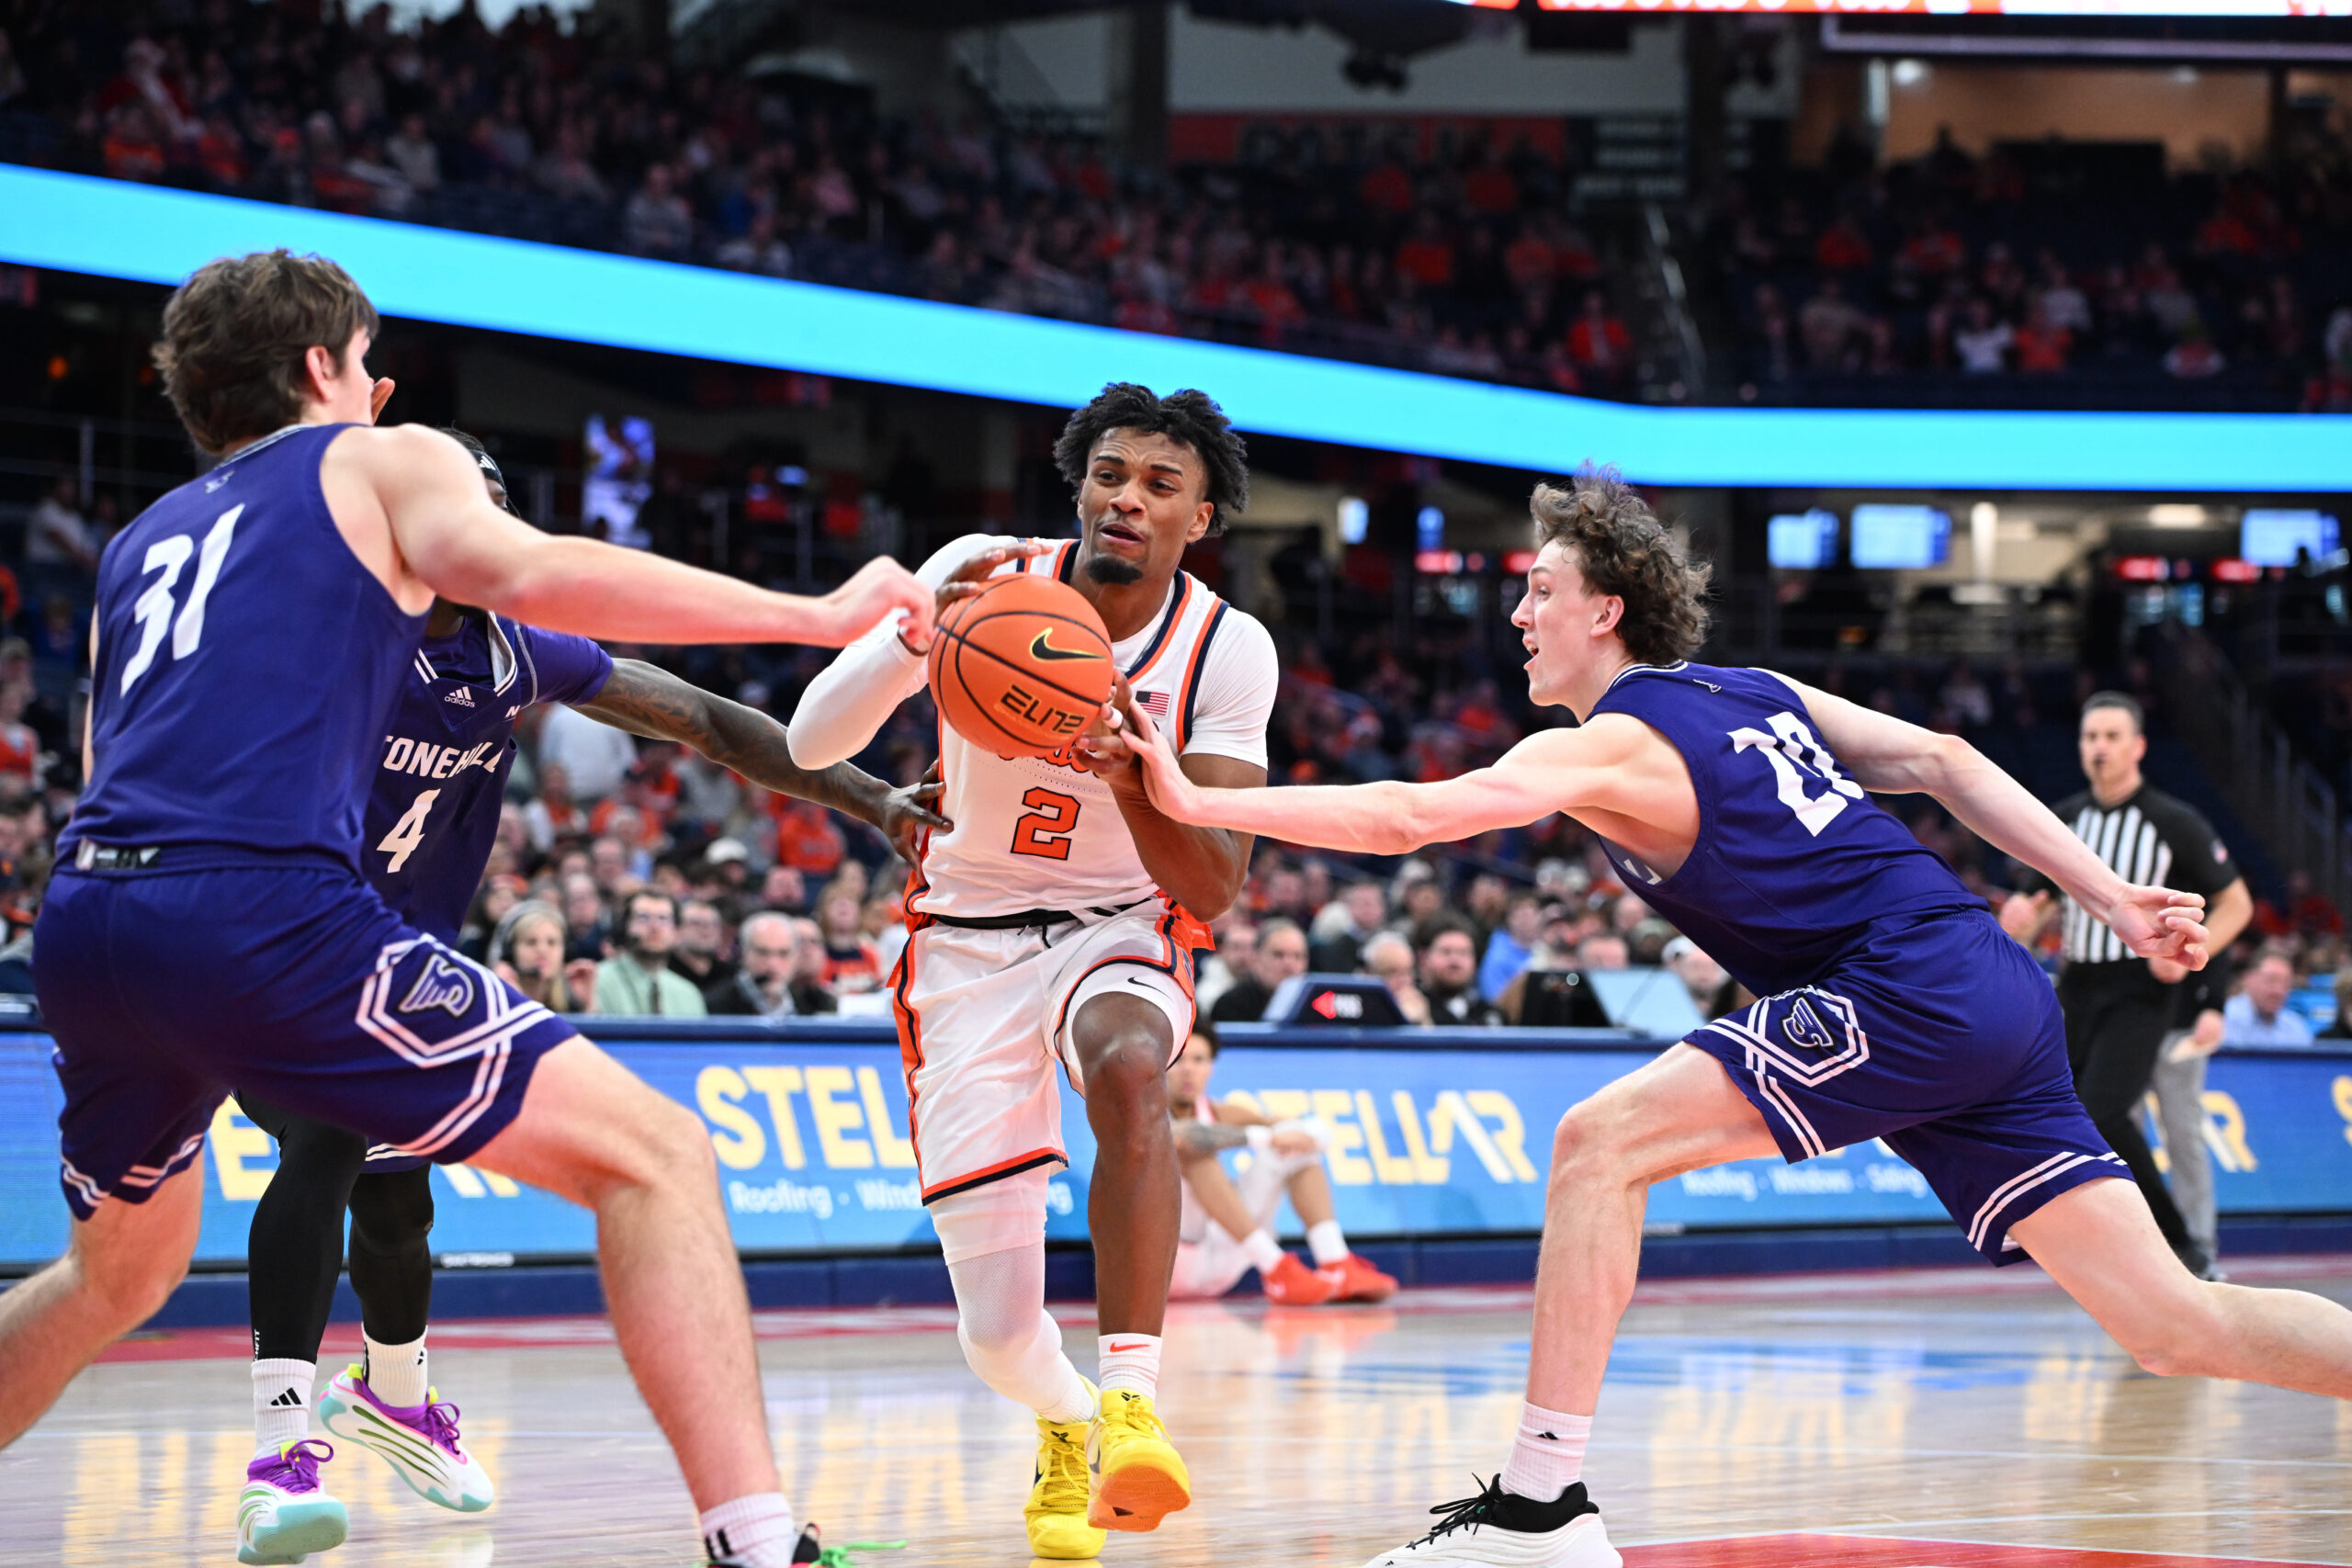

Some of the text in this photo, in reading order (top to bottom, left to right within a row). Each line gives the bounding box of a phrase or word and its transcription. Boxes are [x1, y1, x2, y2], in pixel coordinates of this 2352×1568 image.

[120, 502, 245, 699] 31
[444, 695, 476, 708] adidas
[1000, 683, 1085, 734] ELITE
[384, 735, 504, 779] ONEHILL
[1725, 711, 1865, 837] 20
[376, 788, 441, 874] 4
[1011, 786, 1081, 861] 2
[695, 1066, 910, 1169] STEL
